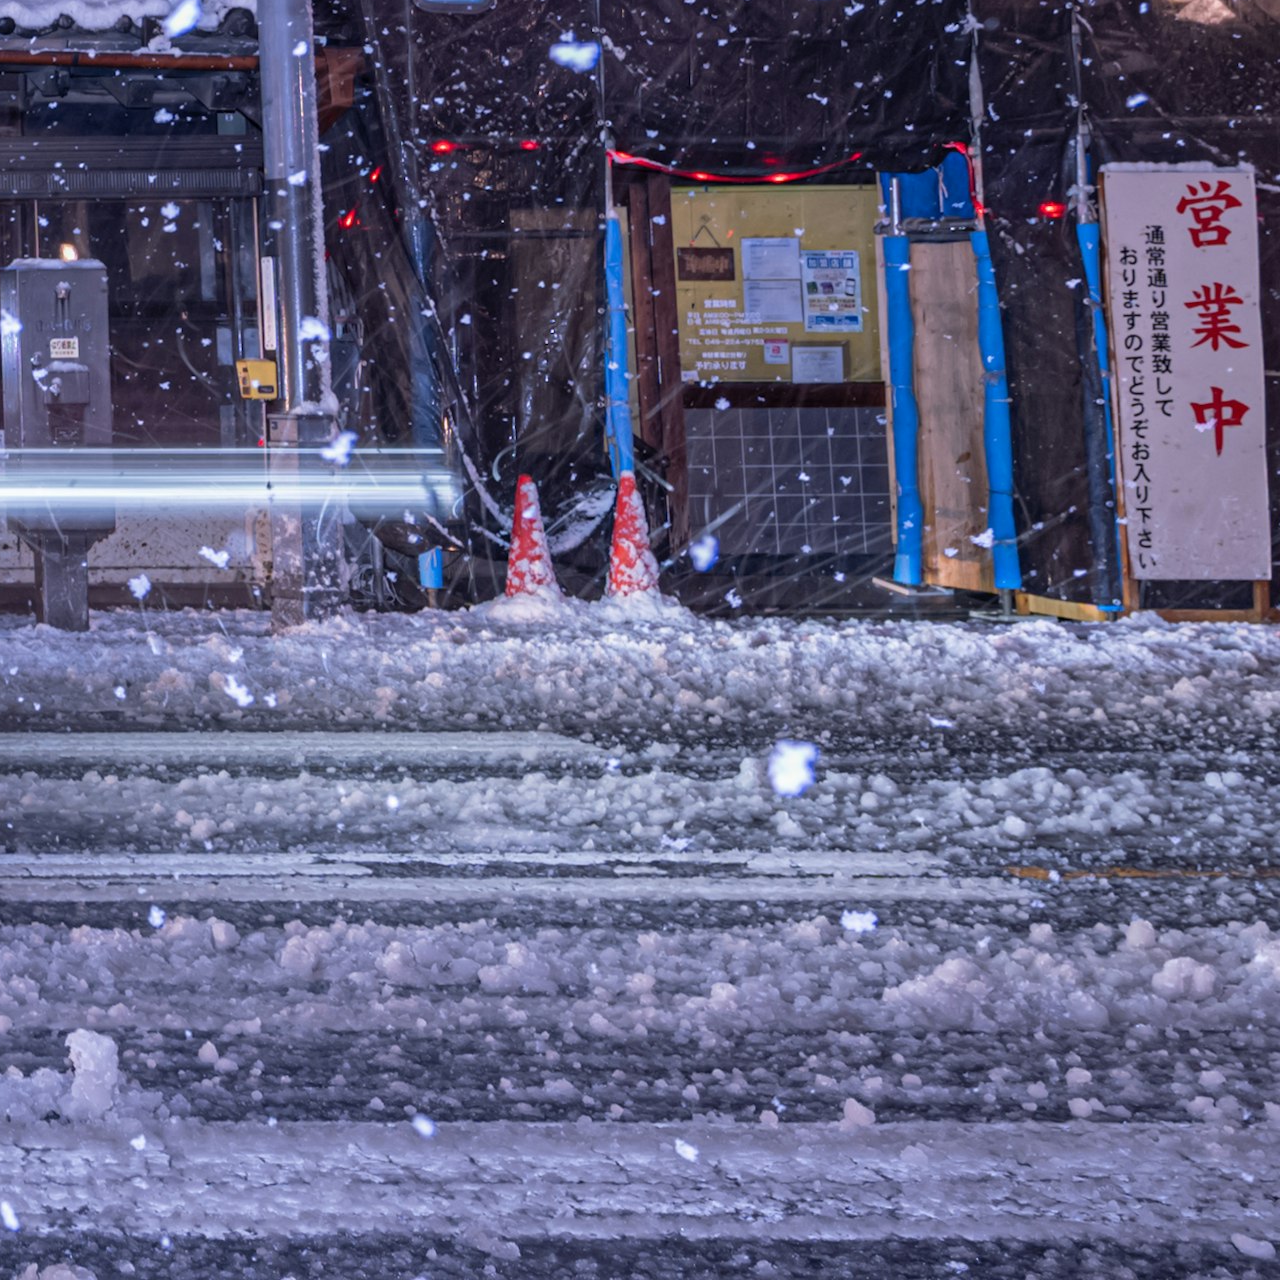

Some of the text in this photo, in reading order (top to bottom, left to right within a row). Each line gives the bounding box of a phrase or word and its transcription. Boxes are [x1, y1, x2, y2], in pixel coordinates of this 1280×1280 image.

[1119, 246, 1157, 569] おりますのでどうぞお入り下さい
[1145, 225, 1173, 417] 通常通り営業致して
[1176, 179, 1252, 457] 営業中
